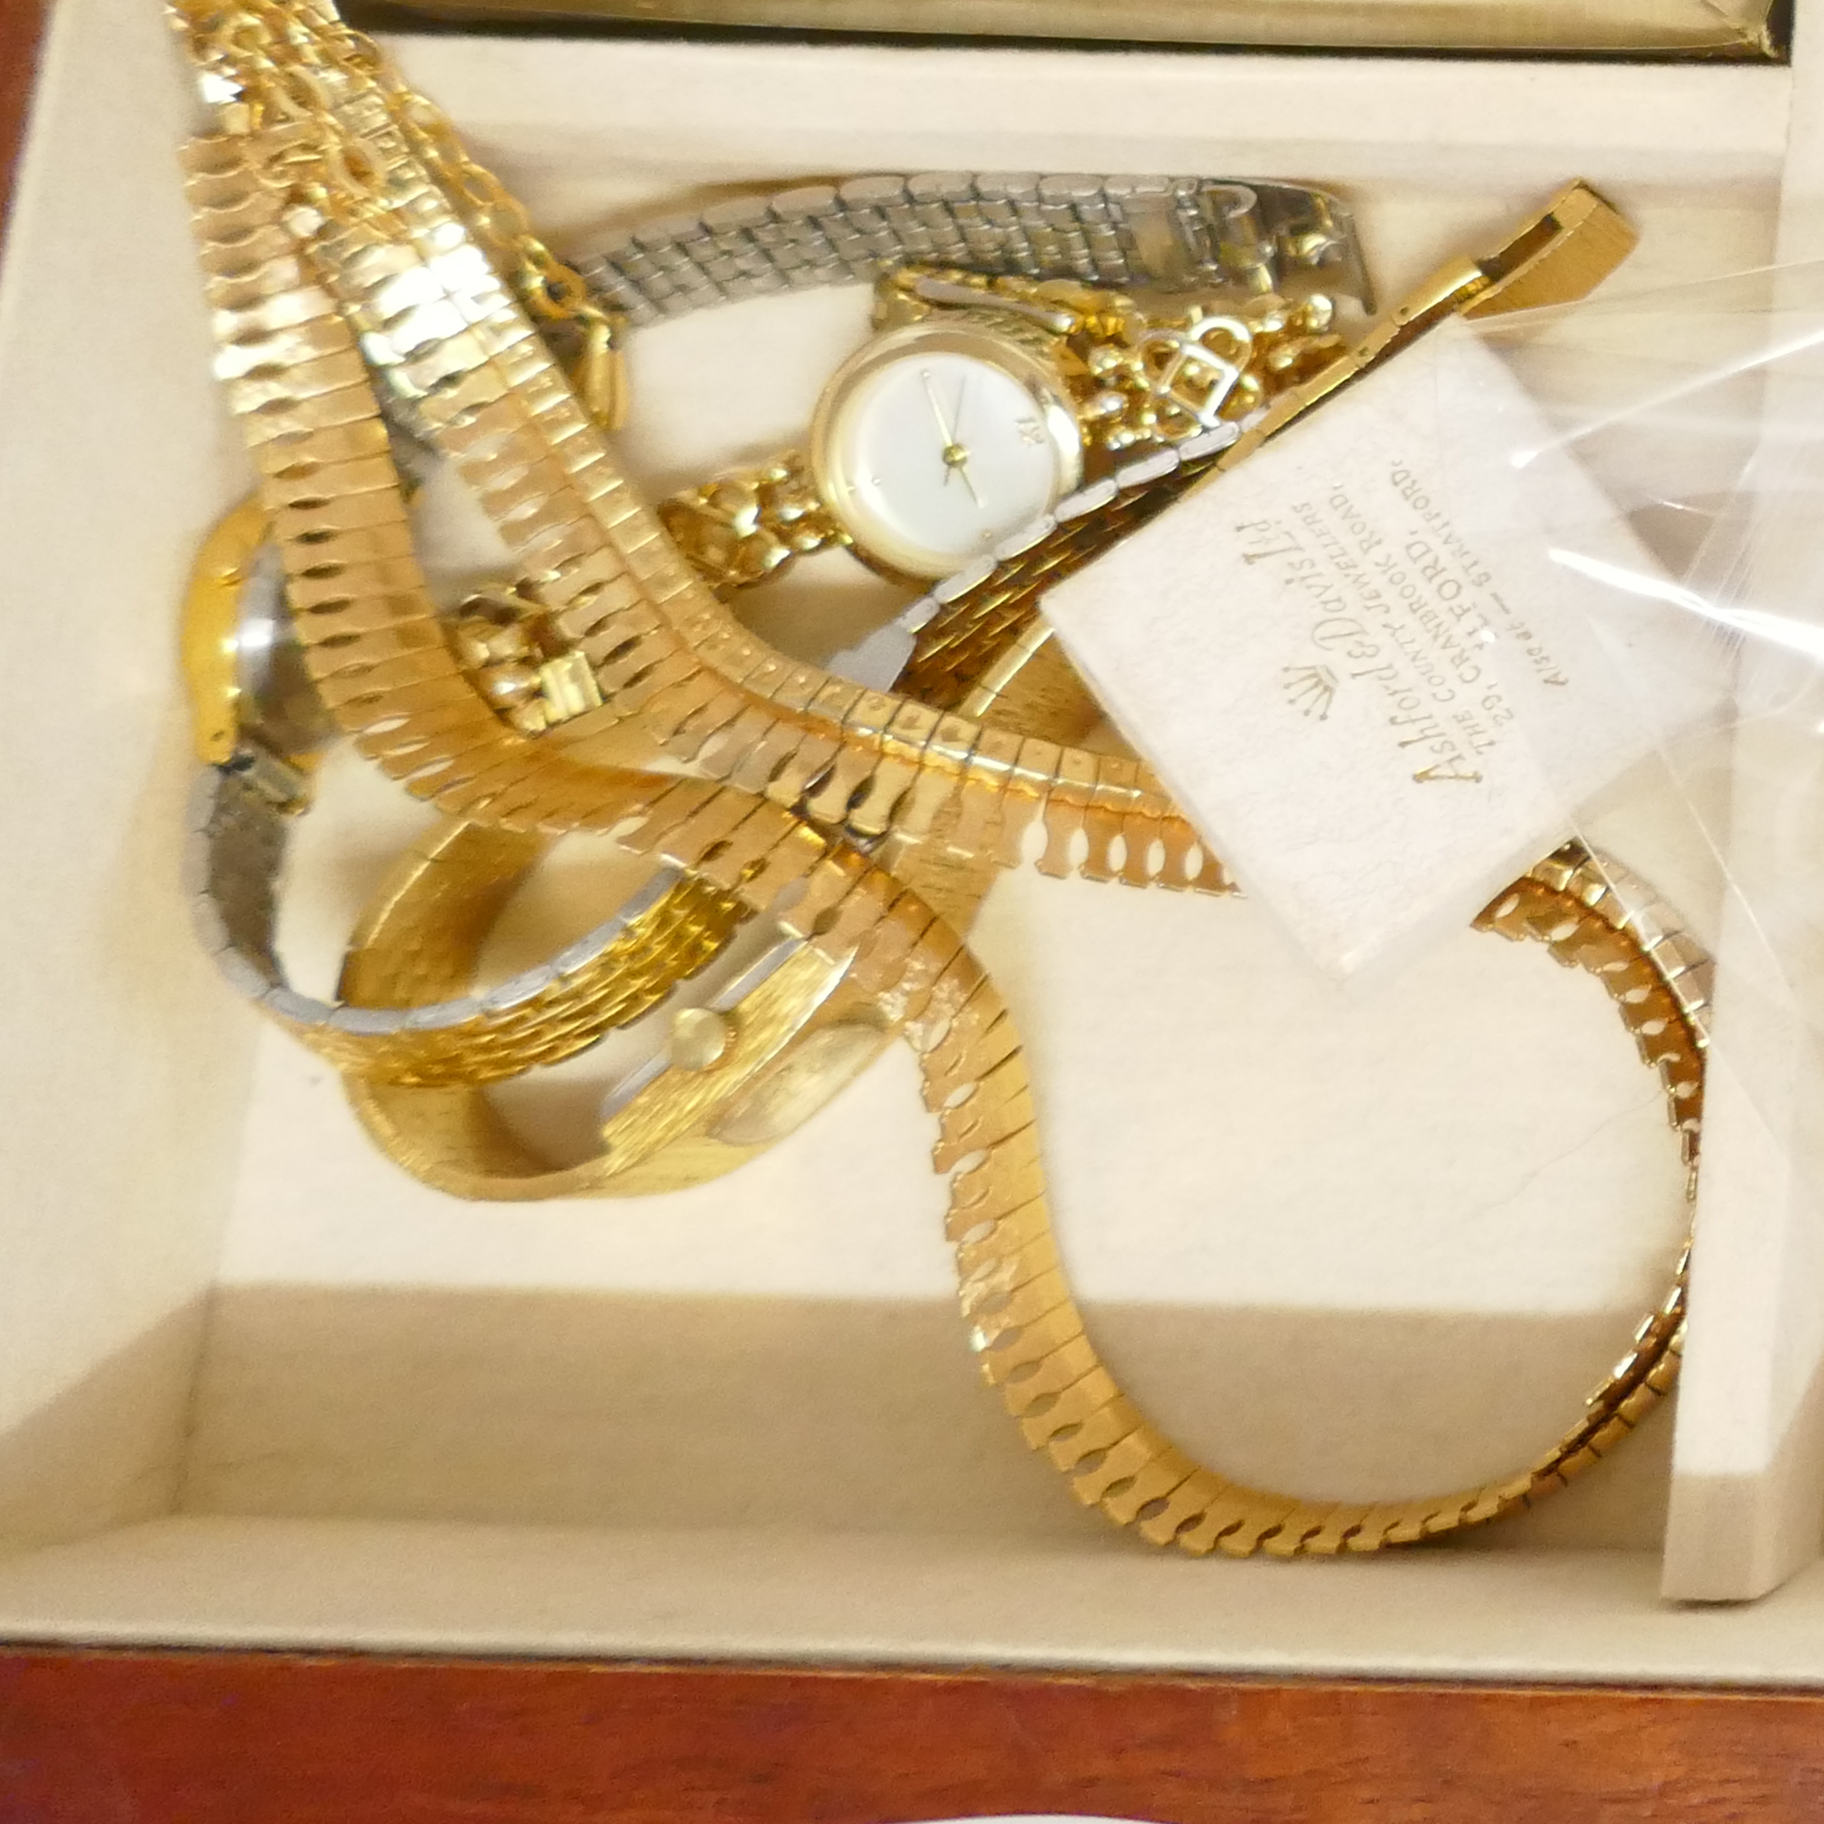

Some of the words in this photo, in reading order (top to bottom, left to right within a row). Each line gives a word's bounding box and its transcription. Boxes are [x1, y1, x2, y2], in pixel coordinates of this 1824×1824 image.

[1328, 485, 1382, 554] ROAD,
[1291, 502, 1390, 613] JEWELLERS
[1283, 561, 1368, 650] Davis
[1374, 554, 1481, 683] CRANBROOK
[1345, 630, 1382, 660] &
[1381, 623, 1455, 702] COUNTY
[1525, 646, 1570, 686] Also
[1350, 664, 1482, 784] Ashford
[1452, 710, 1496, 753] THE
[1480, 683, 1514, 726] 29,
